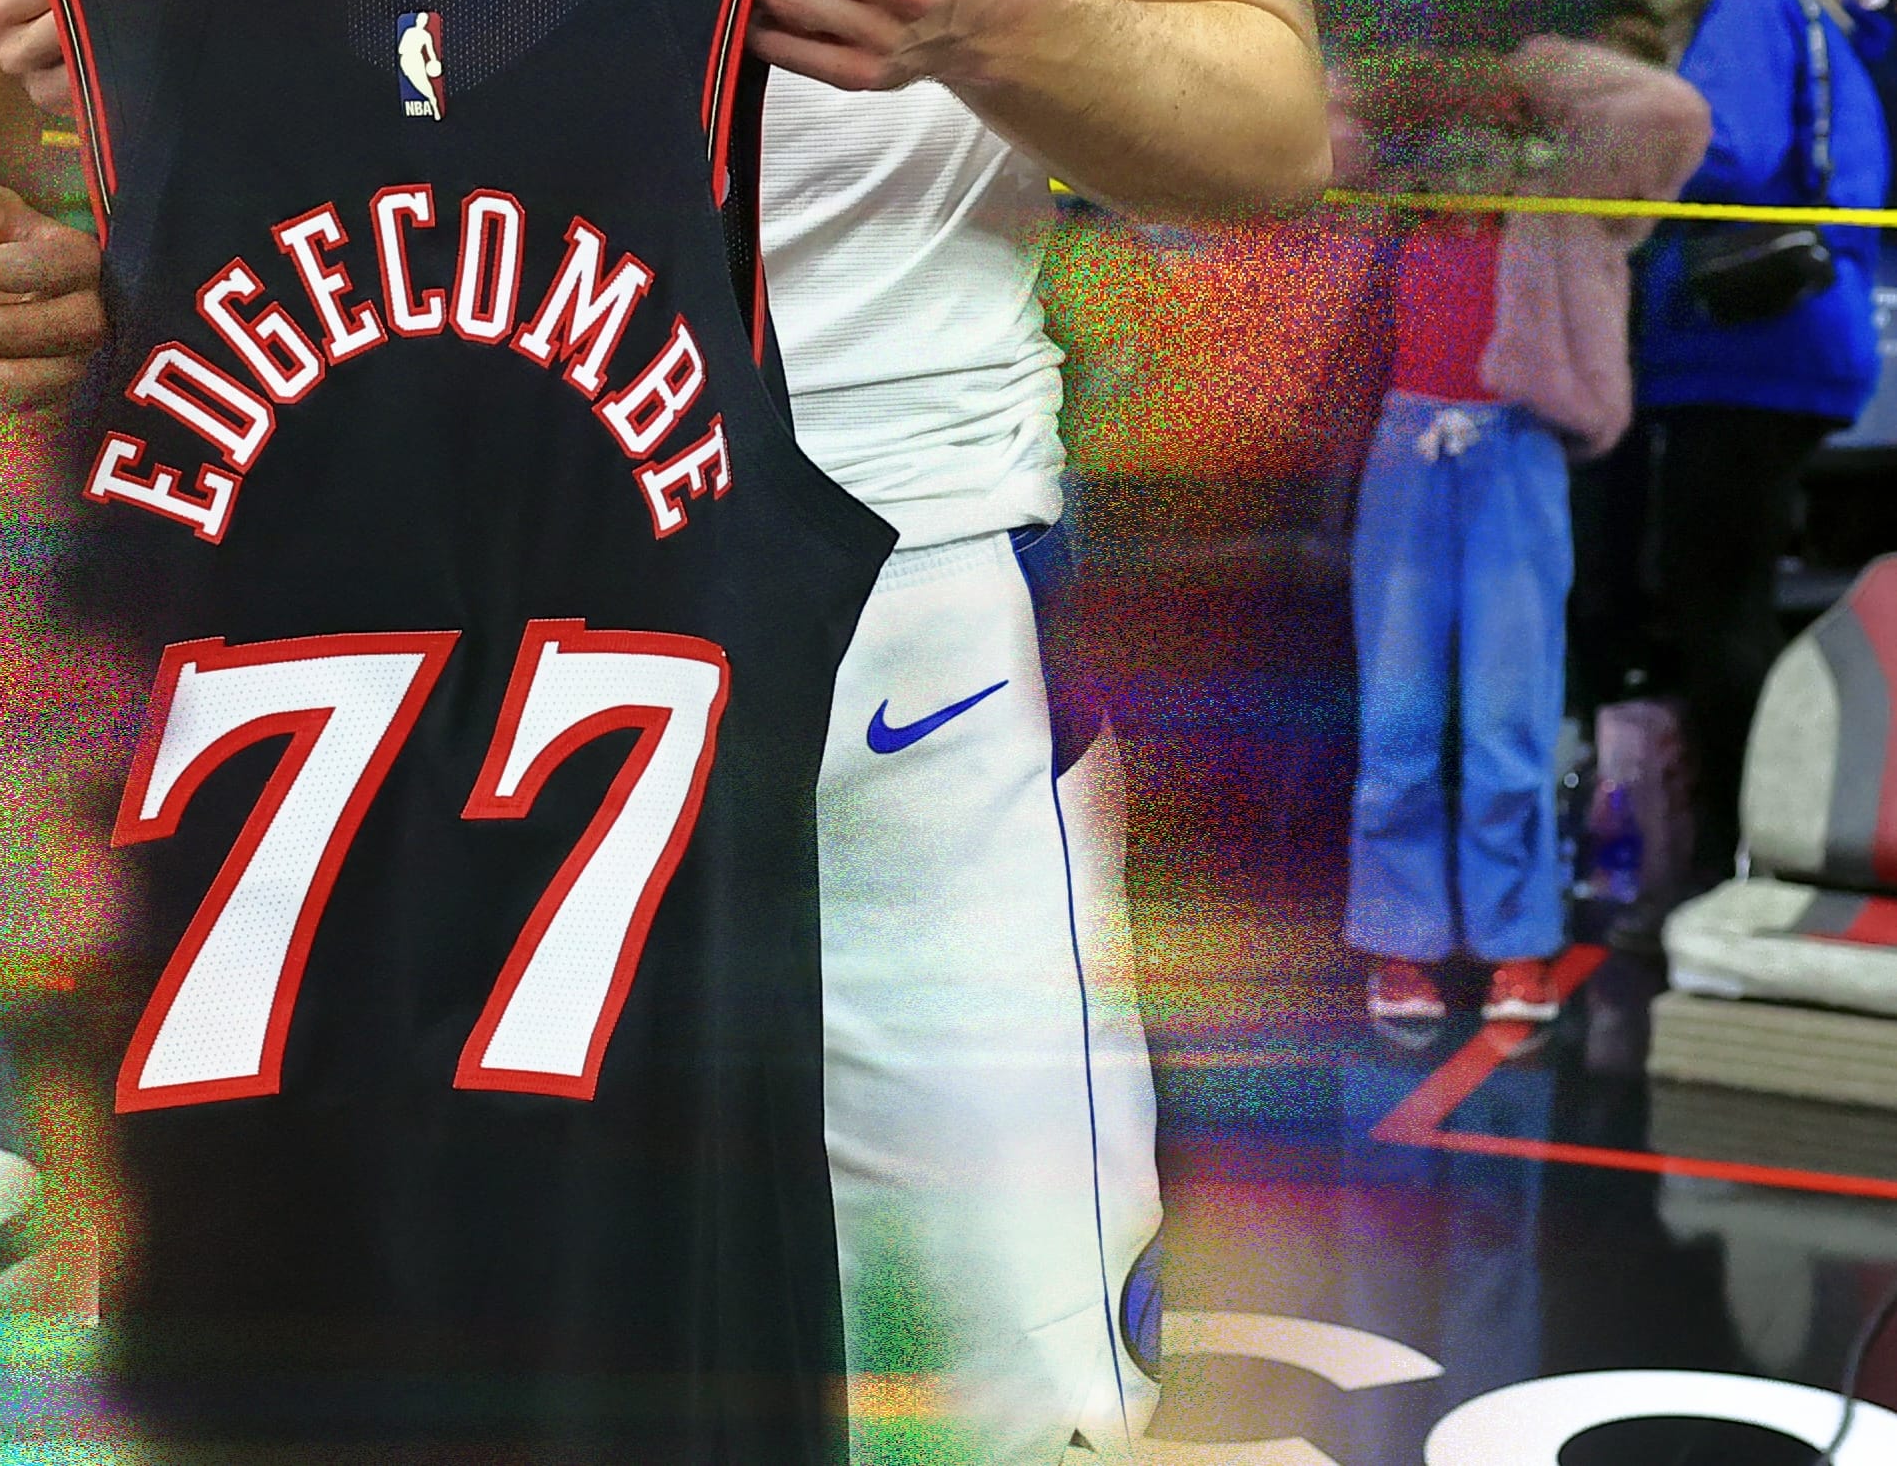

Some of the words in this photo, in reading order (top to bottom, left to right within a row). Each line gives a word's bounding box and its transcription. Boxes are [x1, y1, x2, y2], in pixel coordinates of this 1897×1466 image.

[405, 101, 433, 116] NBA
[82, 183, 733, 545] EDGECOMBE
[111, 617, 732, 1115] 77
